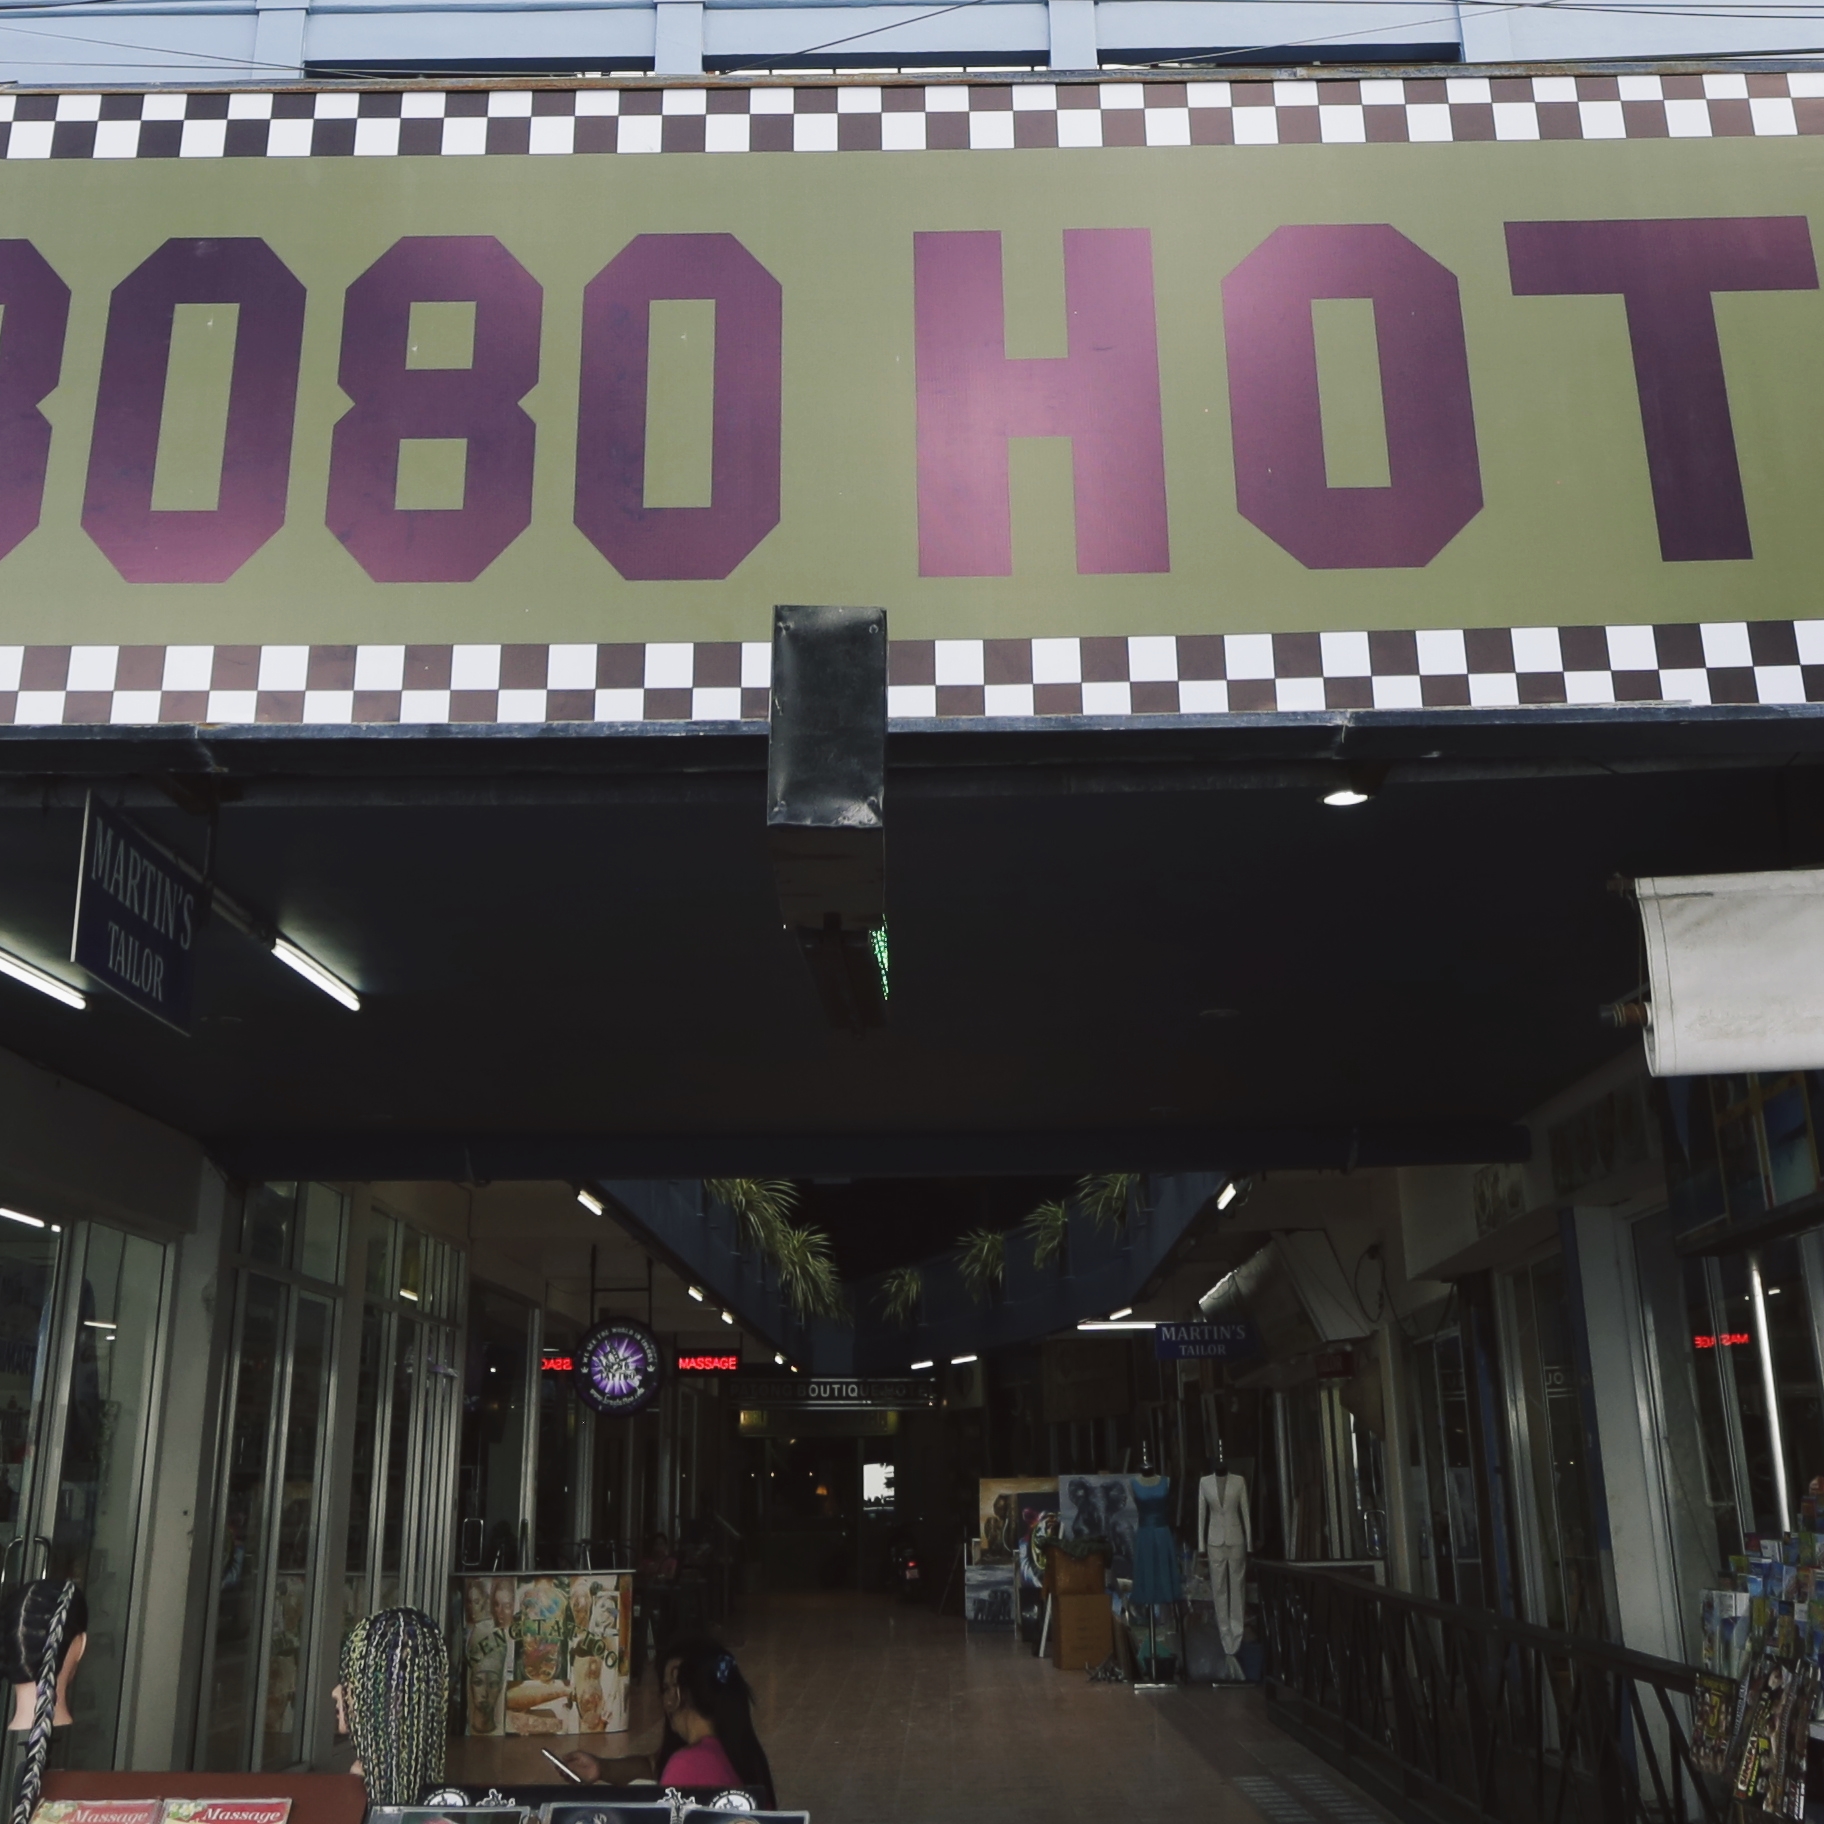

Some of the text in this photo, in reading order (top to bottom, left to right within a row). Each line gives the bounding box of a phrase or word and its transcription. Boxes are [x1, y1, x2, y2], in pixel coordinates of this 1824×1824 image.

[89, 816, 195, 952] MARTIN'S
[106, 919, 165, 1004] TAILOR
[1161, 1323, 1246, 1342] MARTIN'S
[1179, 1342, 1227, 1357] TAILOR
[677, 1356, 739, 1371] MASSAGE
[796, 1381, 881, 1398] BOUTIQUE
[462, 1617, 618, 1669] KENG TATTOO
[70, 1808, 150, 1824] Massage
[204, 1807, 282, 1824] Massage
